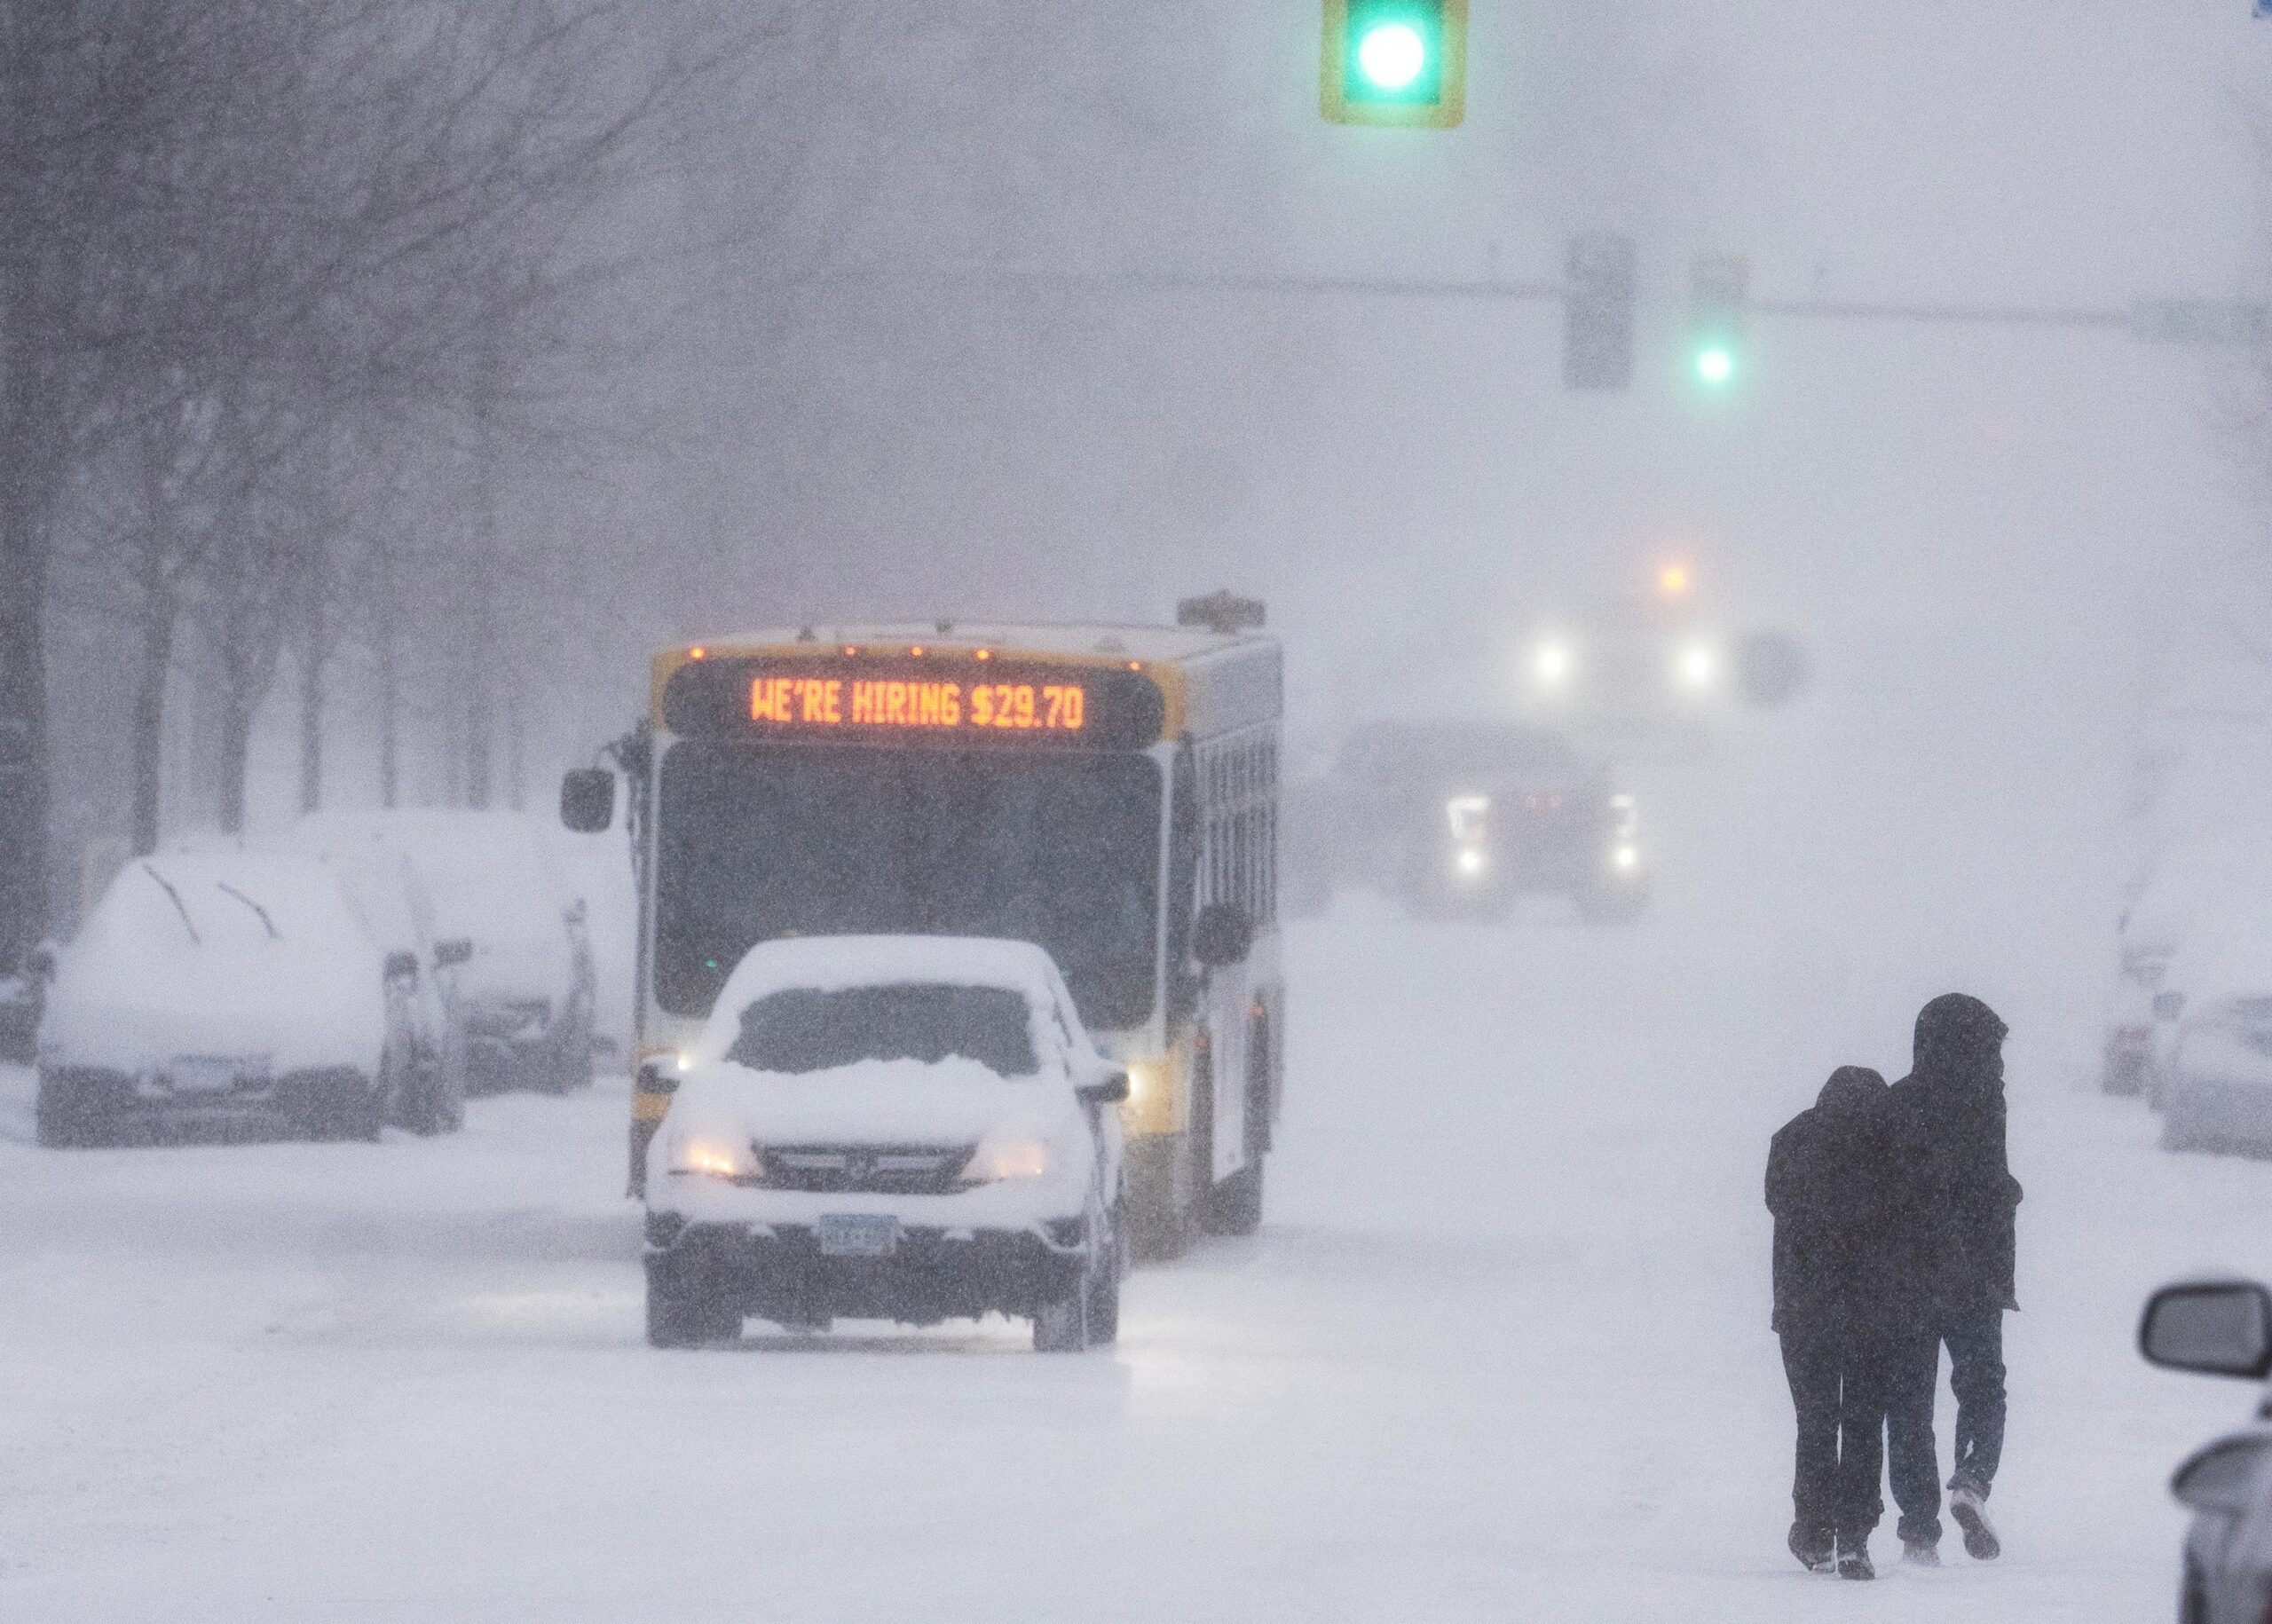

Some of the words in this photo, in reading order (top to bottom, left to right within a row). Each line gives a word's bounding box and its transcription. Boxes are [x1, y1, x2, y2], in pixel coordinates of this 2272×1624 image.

[752, 678, 841, 722] WE'RE
[853, 681, 960, 726] HIRING
[971, 685, 1084, 729] $29.70
